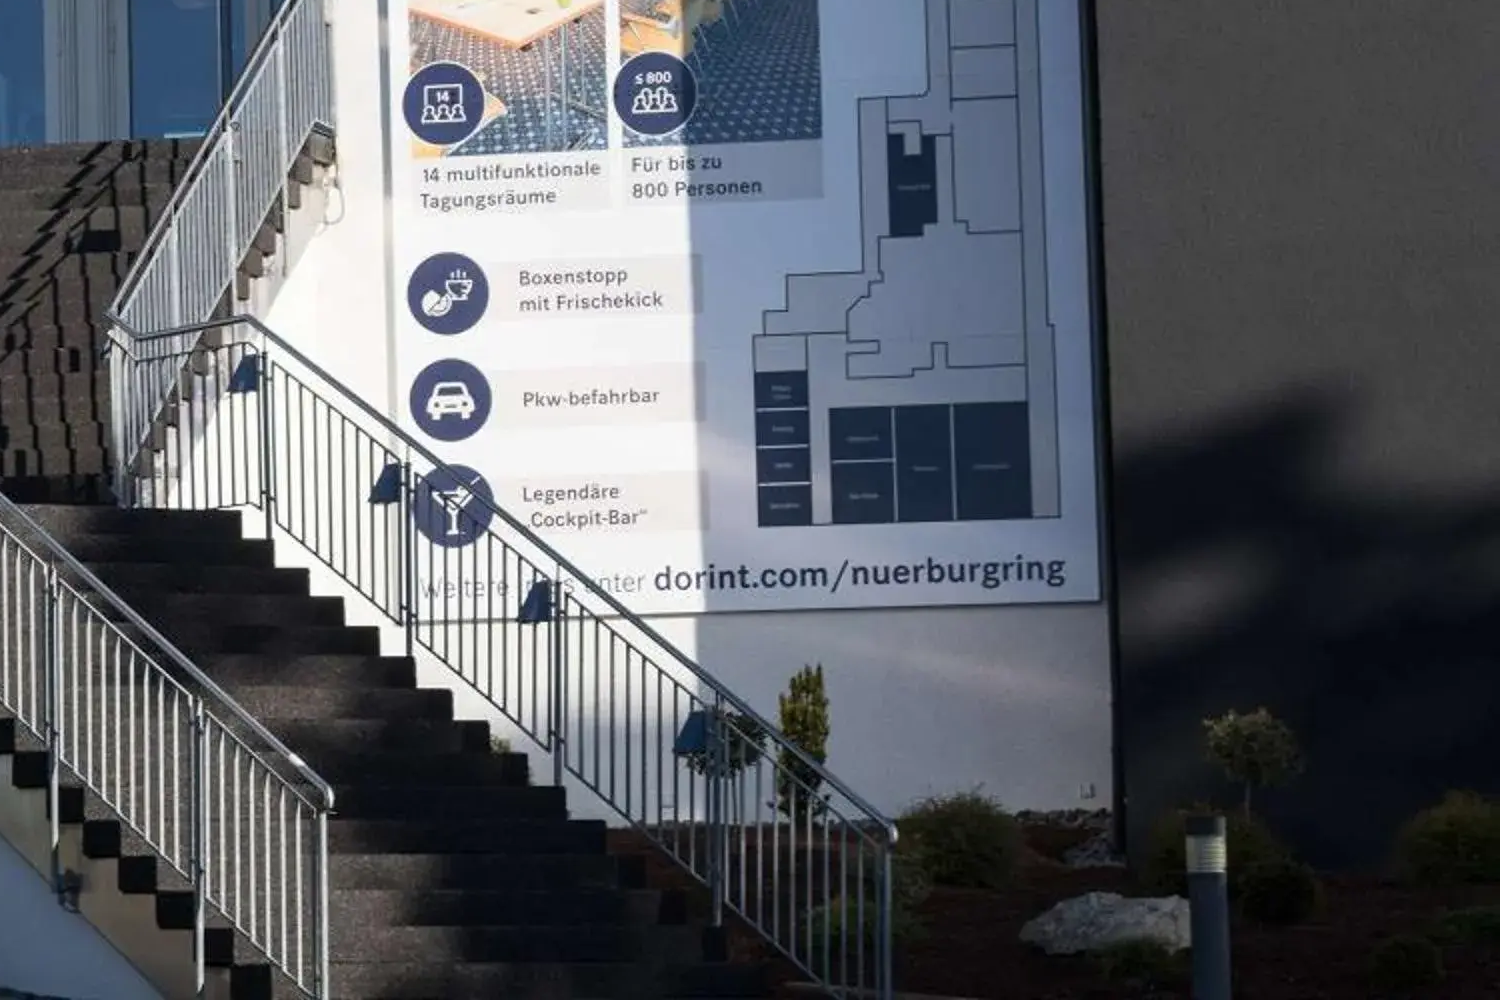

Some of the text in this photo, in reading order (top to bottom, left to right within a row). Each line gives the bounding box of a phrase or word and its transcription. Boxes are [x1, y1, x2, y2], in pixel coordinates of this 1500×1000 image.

[646, 70, 673, 85] 800
[422, 161, 601, 183] 14 multifunktionale
[631, 154, 722, 174] Für bis zu
[632, 179, 763, 198] 800 Personen
[420, 191, 557, 212] Tagungsräume
[519, 269, 628, 287] Boxenstopp
[519, 291, 664, 312] mit Frischekick
[522, 388, 660, 407] Pkw-befahrbar
[522, 482, 620, 505] Legendäre
[419, 577, 507, 599] Wetere
[654, 554, 1067, 593] dorint.com/nuerburgring
